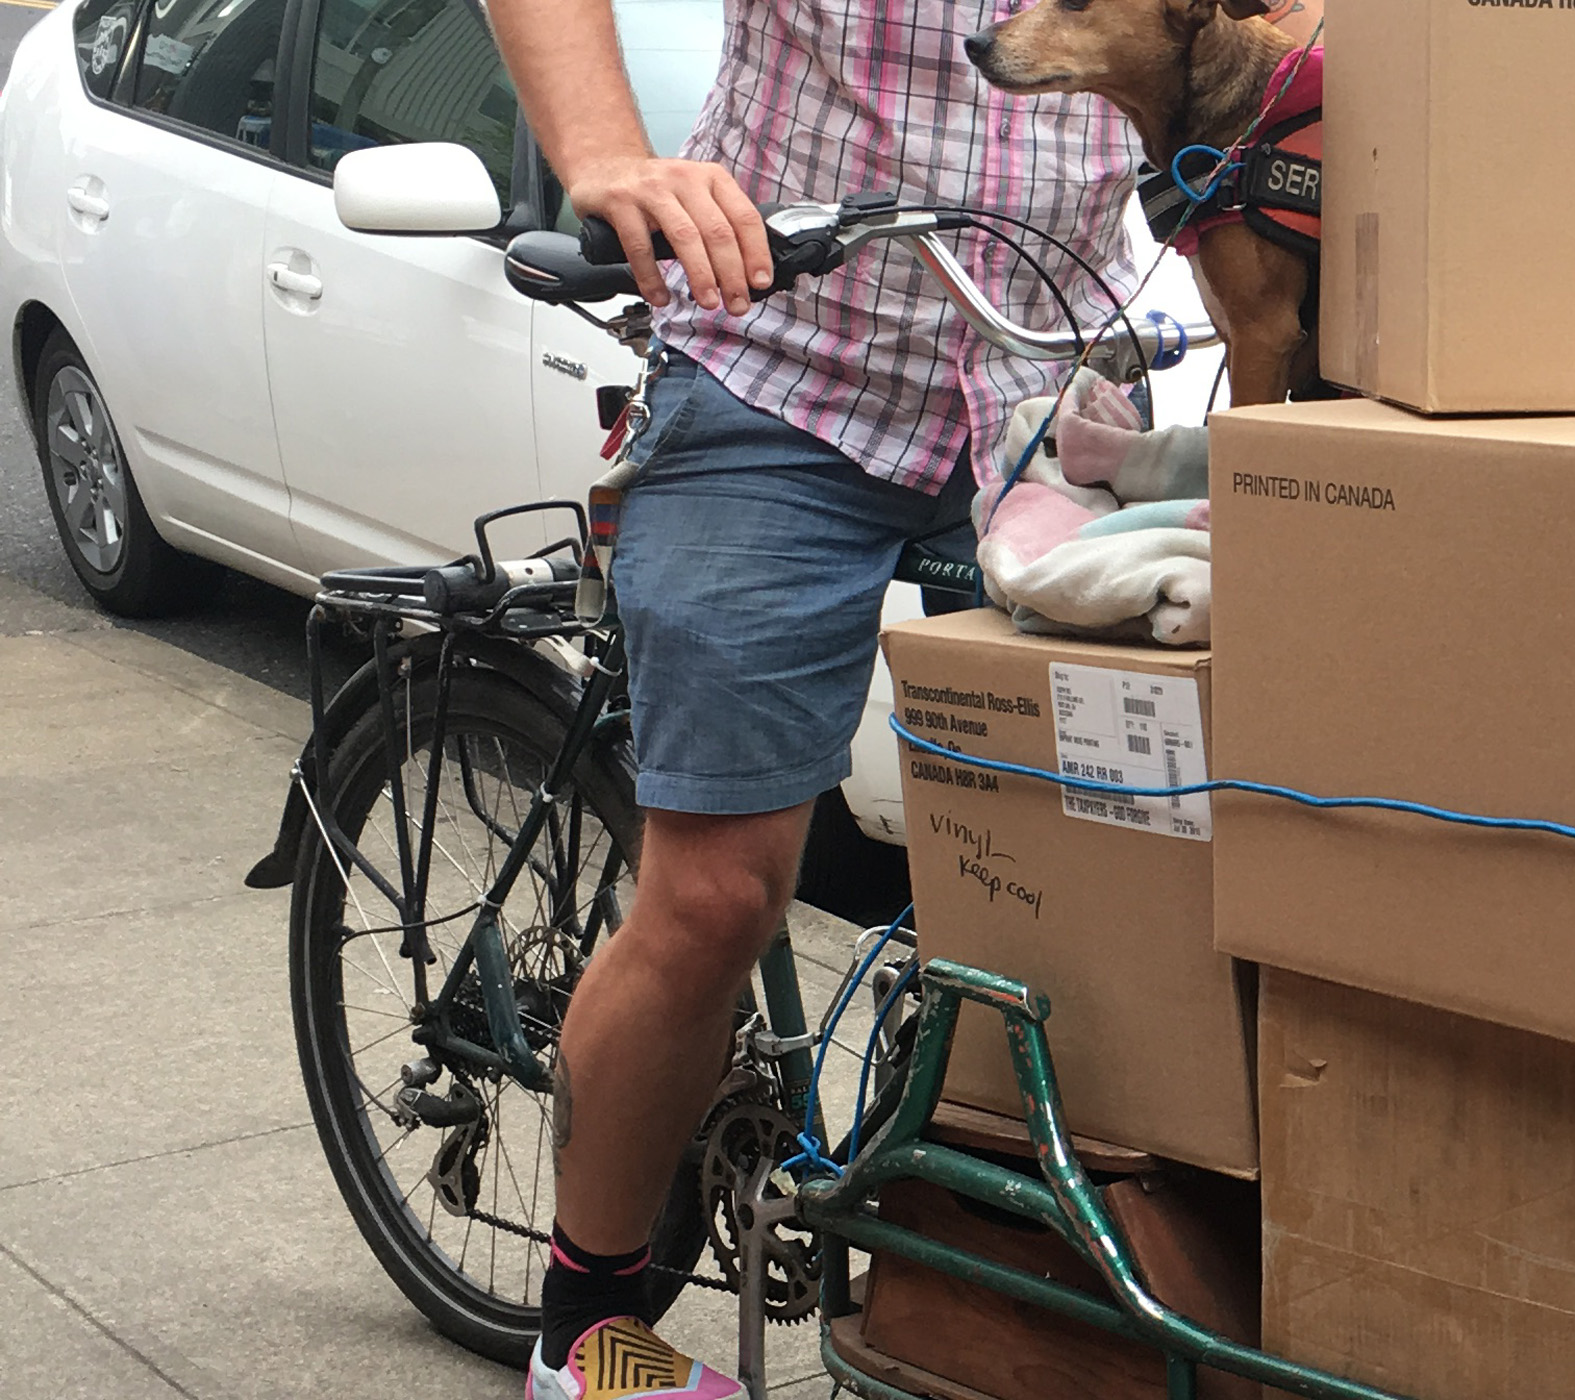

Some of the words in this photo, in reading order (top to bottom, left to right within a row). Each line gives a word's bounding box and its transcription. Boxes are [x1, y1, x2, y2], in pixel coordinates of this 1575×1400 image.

[1233, 472, 1300, 500] PRINTED
[1304, 480, 1321, 502] IN
[1324, 482, 1396, 511] CANADA
[901, 680, 985, 710] Transcontinental
[987, 692, 1041, 717] Ross-Ellis
[904, 707, 925, 727] 999
[925, 710, 949, 731] 90th
[950, 714, 988, 737] Avenue
[911, 760, 954, 785] CANADA
[955, 766, 977, 790] H8R
[978, 771, 999, 793] 3A4
[1062, 760, 1079, 776] AMR
[1080, 763, 1095, 779] 242
[1096, 766, 1108, 781] RR
[1109, 768, 1124, 784] 003
[1006, 881, 1043, 919] cool
